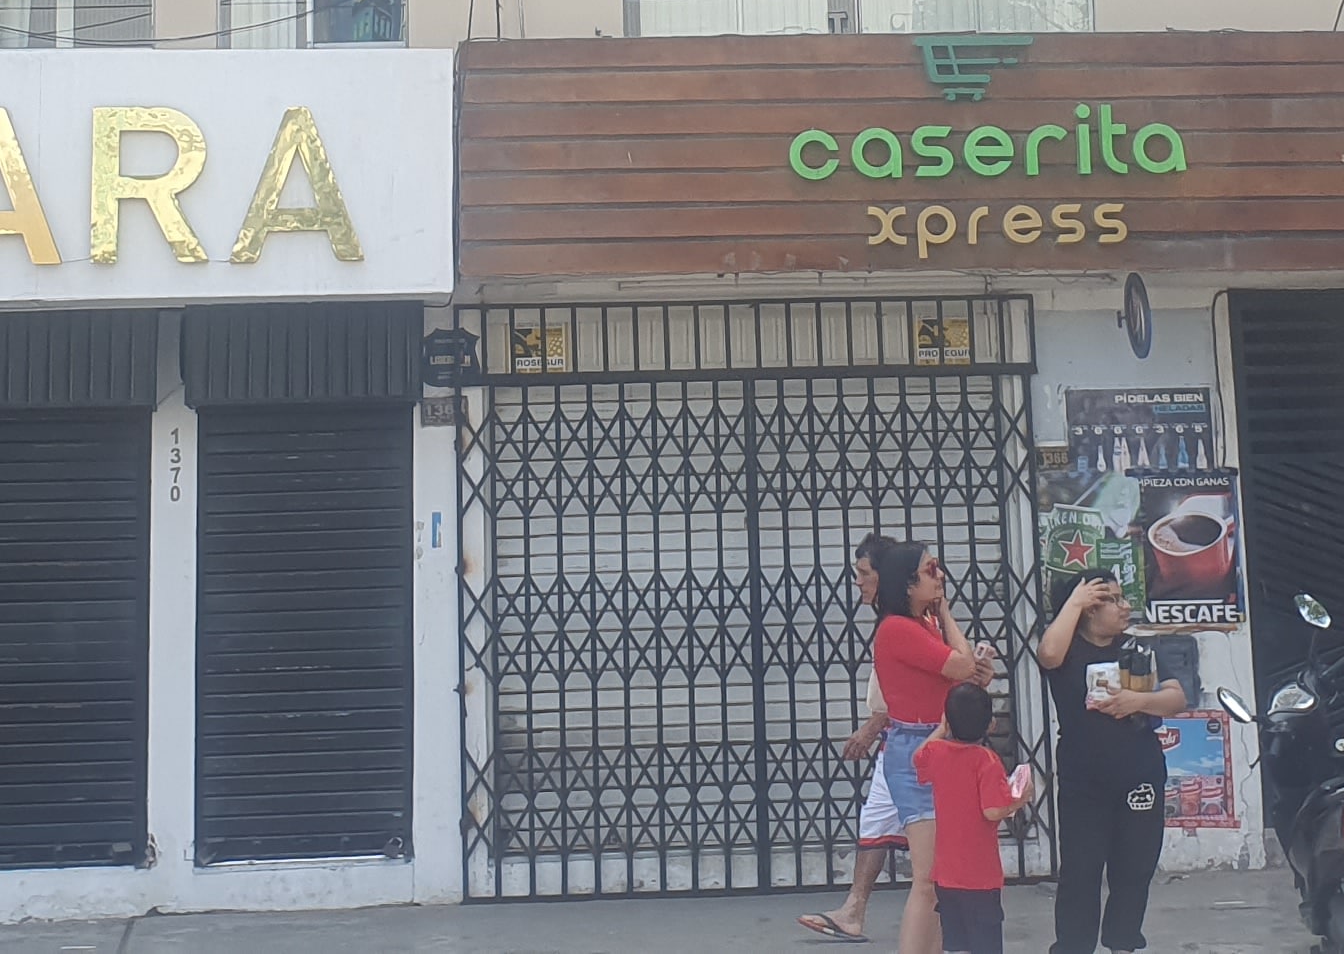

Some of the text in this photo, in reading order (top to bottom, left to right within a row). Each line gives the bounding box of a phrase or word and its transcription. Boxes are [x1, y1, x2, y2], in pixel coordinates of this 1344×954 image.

[789, 104, 1187, 180] caserita
[866, 203, 1128, 260] xpress
[1174, 393, 1204, 402] BIEN
[169, 428, 182, 502] 1370
[1196, 476, 1230, 487] GANAS
